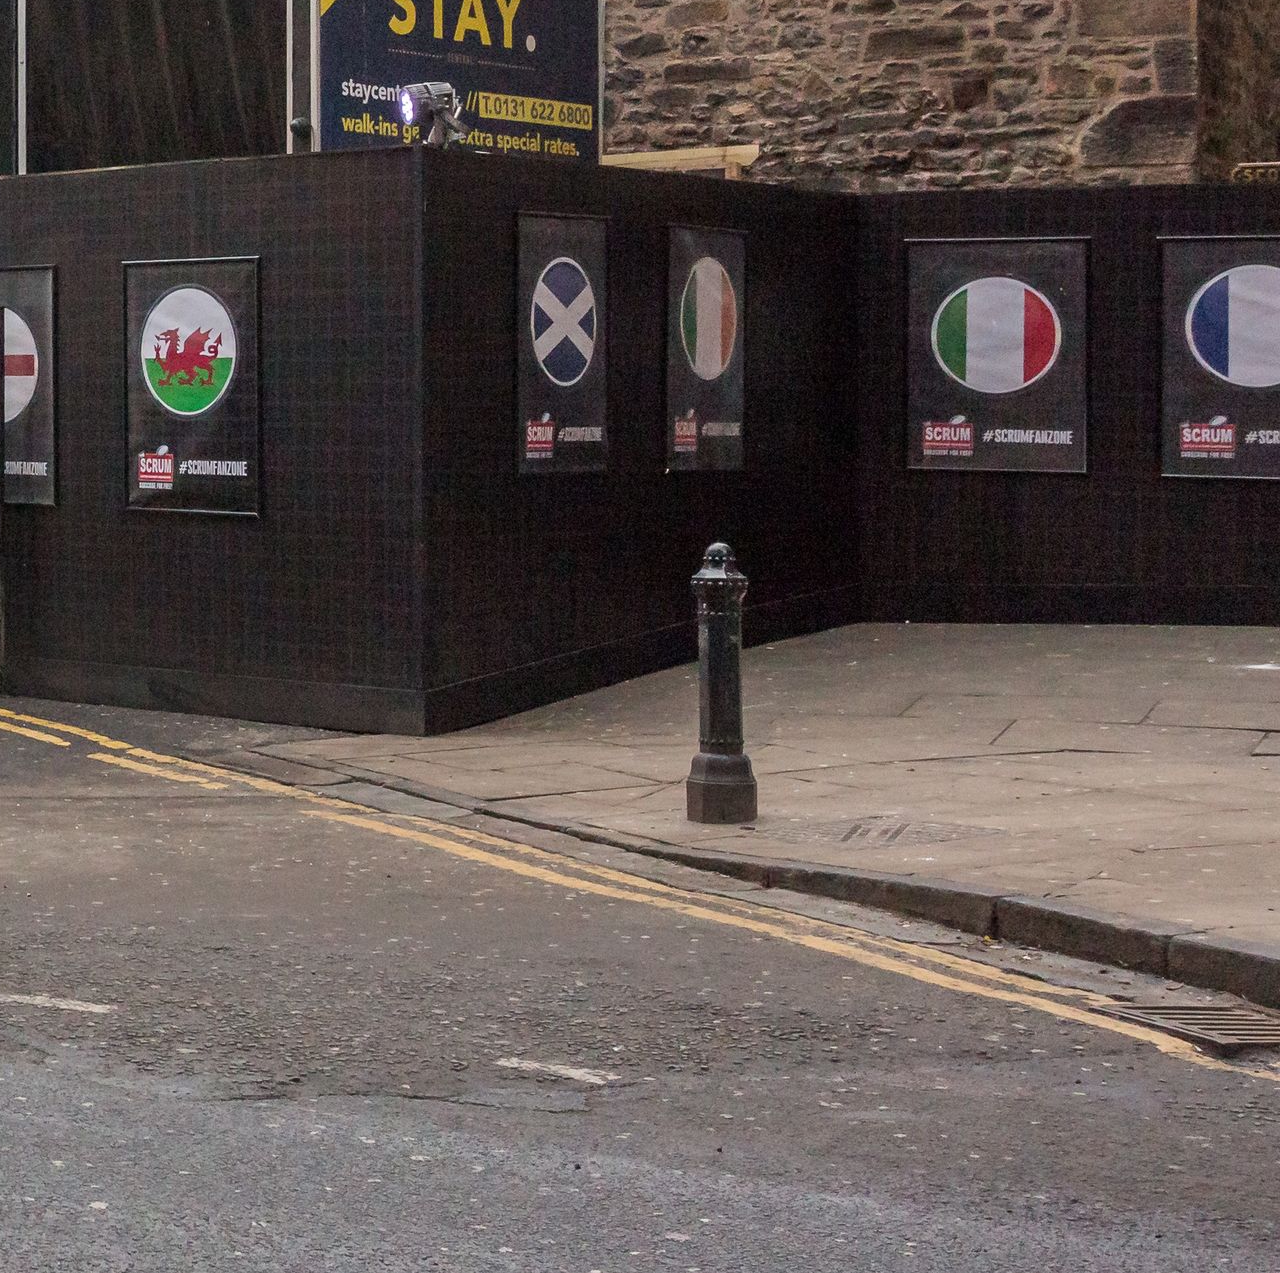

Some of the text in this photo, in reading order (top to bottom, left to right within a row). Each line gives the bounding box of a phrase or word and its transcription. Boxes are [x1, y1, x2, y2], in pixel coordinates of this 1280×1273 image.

[530, 101, 554, 122] 622
[559, 104, 589, 125] 6800
[342, 113, 398, 137] walk-ins
[403, 124, 420, 145] ge
[497, 131, 540, 154] special
[544, 138, 580, 156] rates.
[527, 426, 553, 441] SCRUM
[925, 427, 1074, 445] SCRUM #SCRUMFANZONE
[1182, 428, 1232, 443] SCRUM
[140, 458, 248, 477] SCRUM #SCRUMFANZONE
